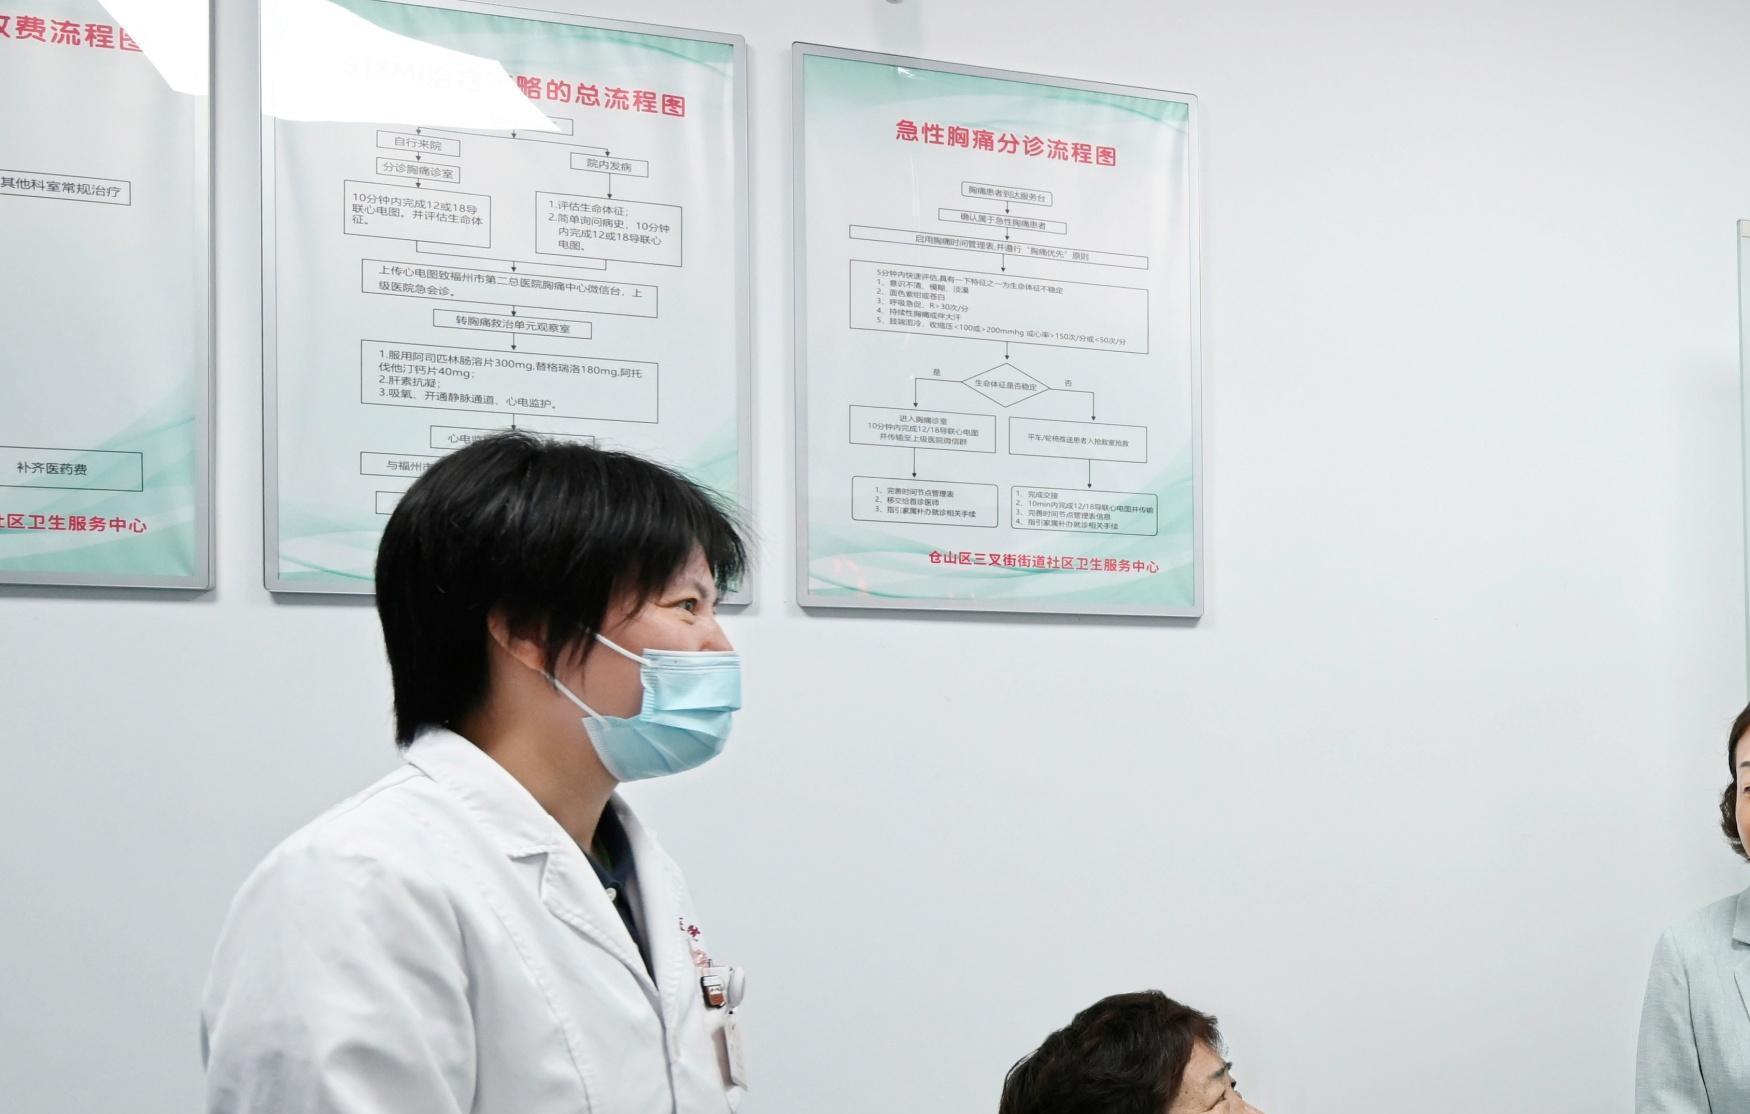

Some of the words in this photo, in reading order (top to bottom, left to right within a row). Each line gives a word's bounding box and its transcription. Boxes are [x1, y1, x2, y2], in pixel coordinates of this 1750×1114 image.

[394, 136, 443, 152] 自行来院
[895, 118, 1117, 167] 急性胸痛分诊流程图
[383, 161, 455, 180] 分诊胸痛诊室
[586, 158, 632, 173] 院内发病
[1, 176, 121, 198] 其他科室常规治疗
[352, 193, 478, 215] 10分钟内完成12或18导
[558, 227, 662, 246] 内完成12或18导联心
[17, 461, 88, 477] 补齐医药费
[0, 513, 147, 533] 区卫生服务中心
[928, 550, 1160, 575] 仓山区三叉街街道社区卫生服务中心
